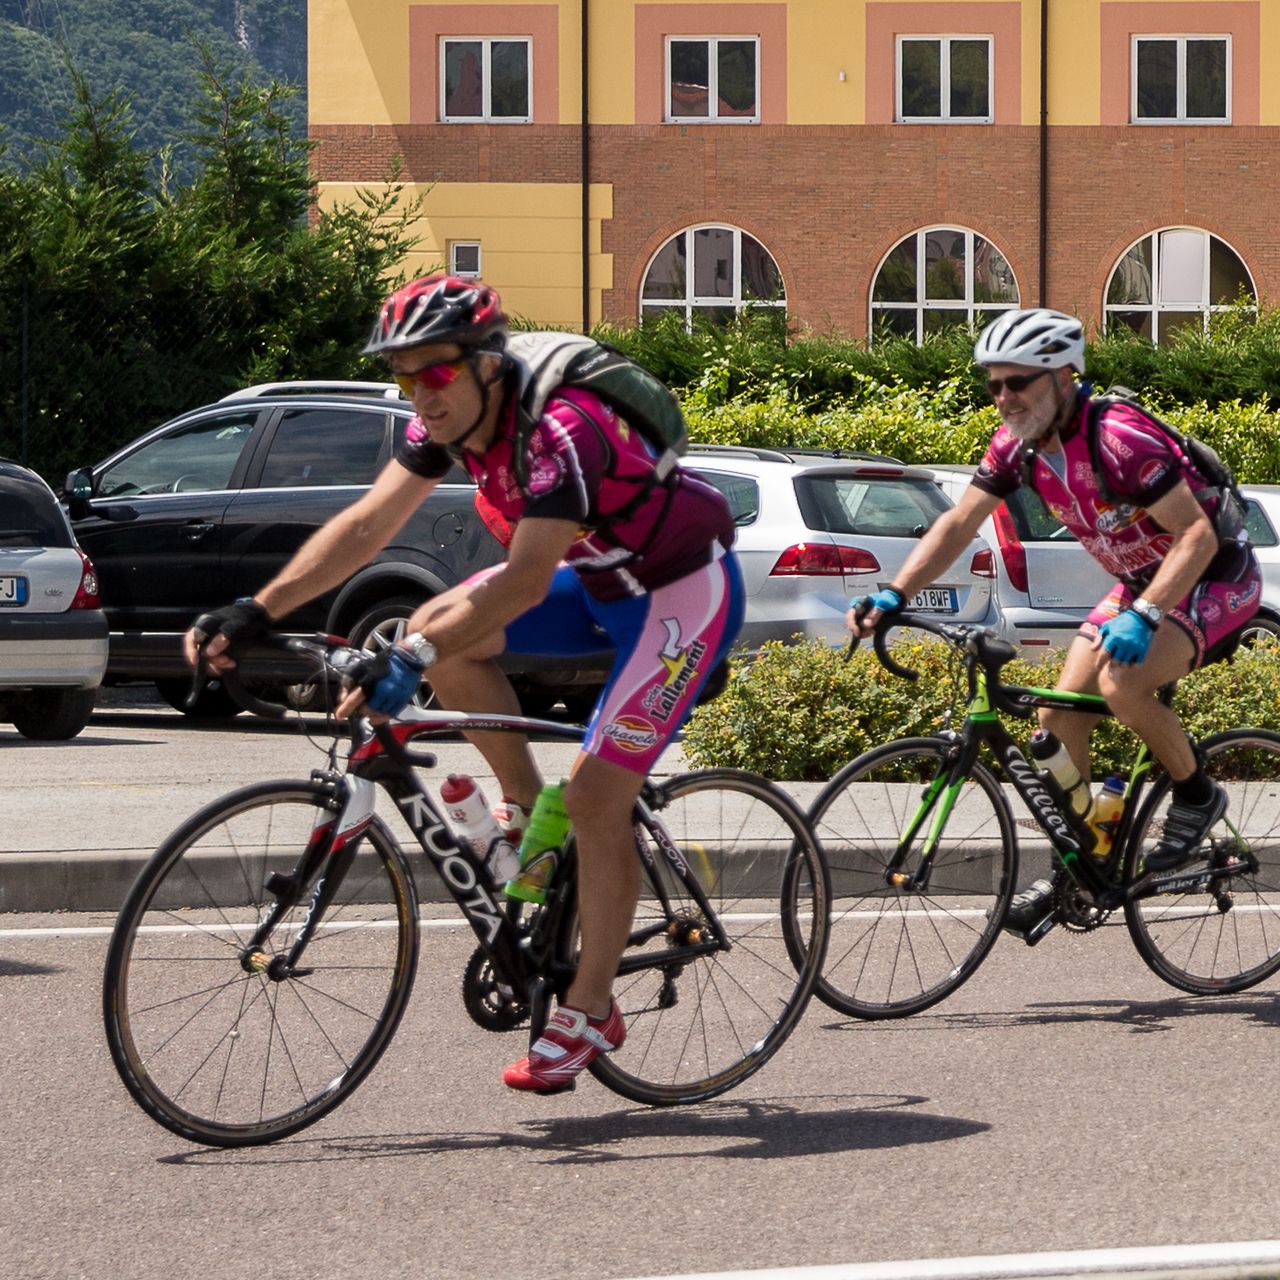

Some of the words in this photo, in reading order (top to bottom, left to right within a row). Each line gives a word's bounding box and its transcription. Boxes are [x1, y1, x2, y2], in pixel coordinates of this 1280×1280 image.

[650, 638, 707, 723] Lallement
[1006, 744, 1081, 851] Wilier
[400, 792, 503, 945] KUOTA
